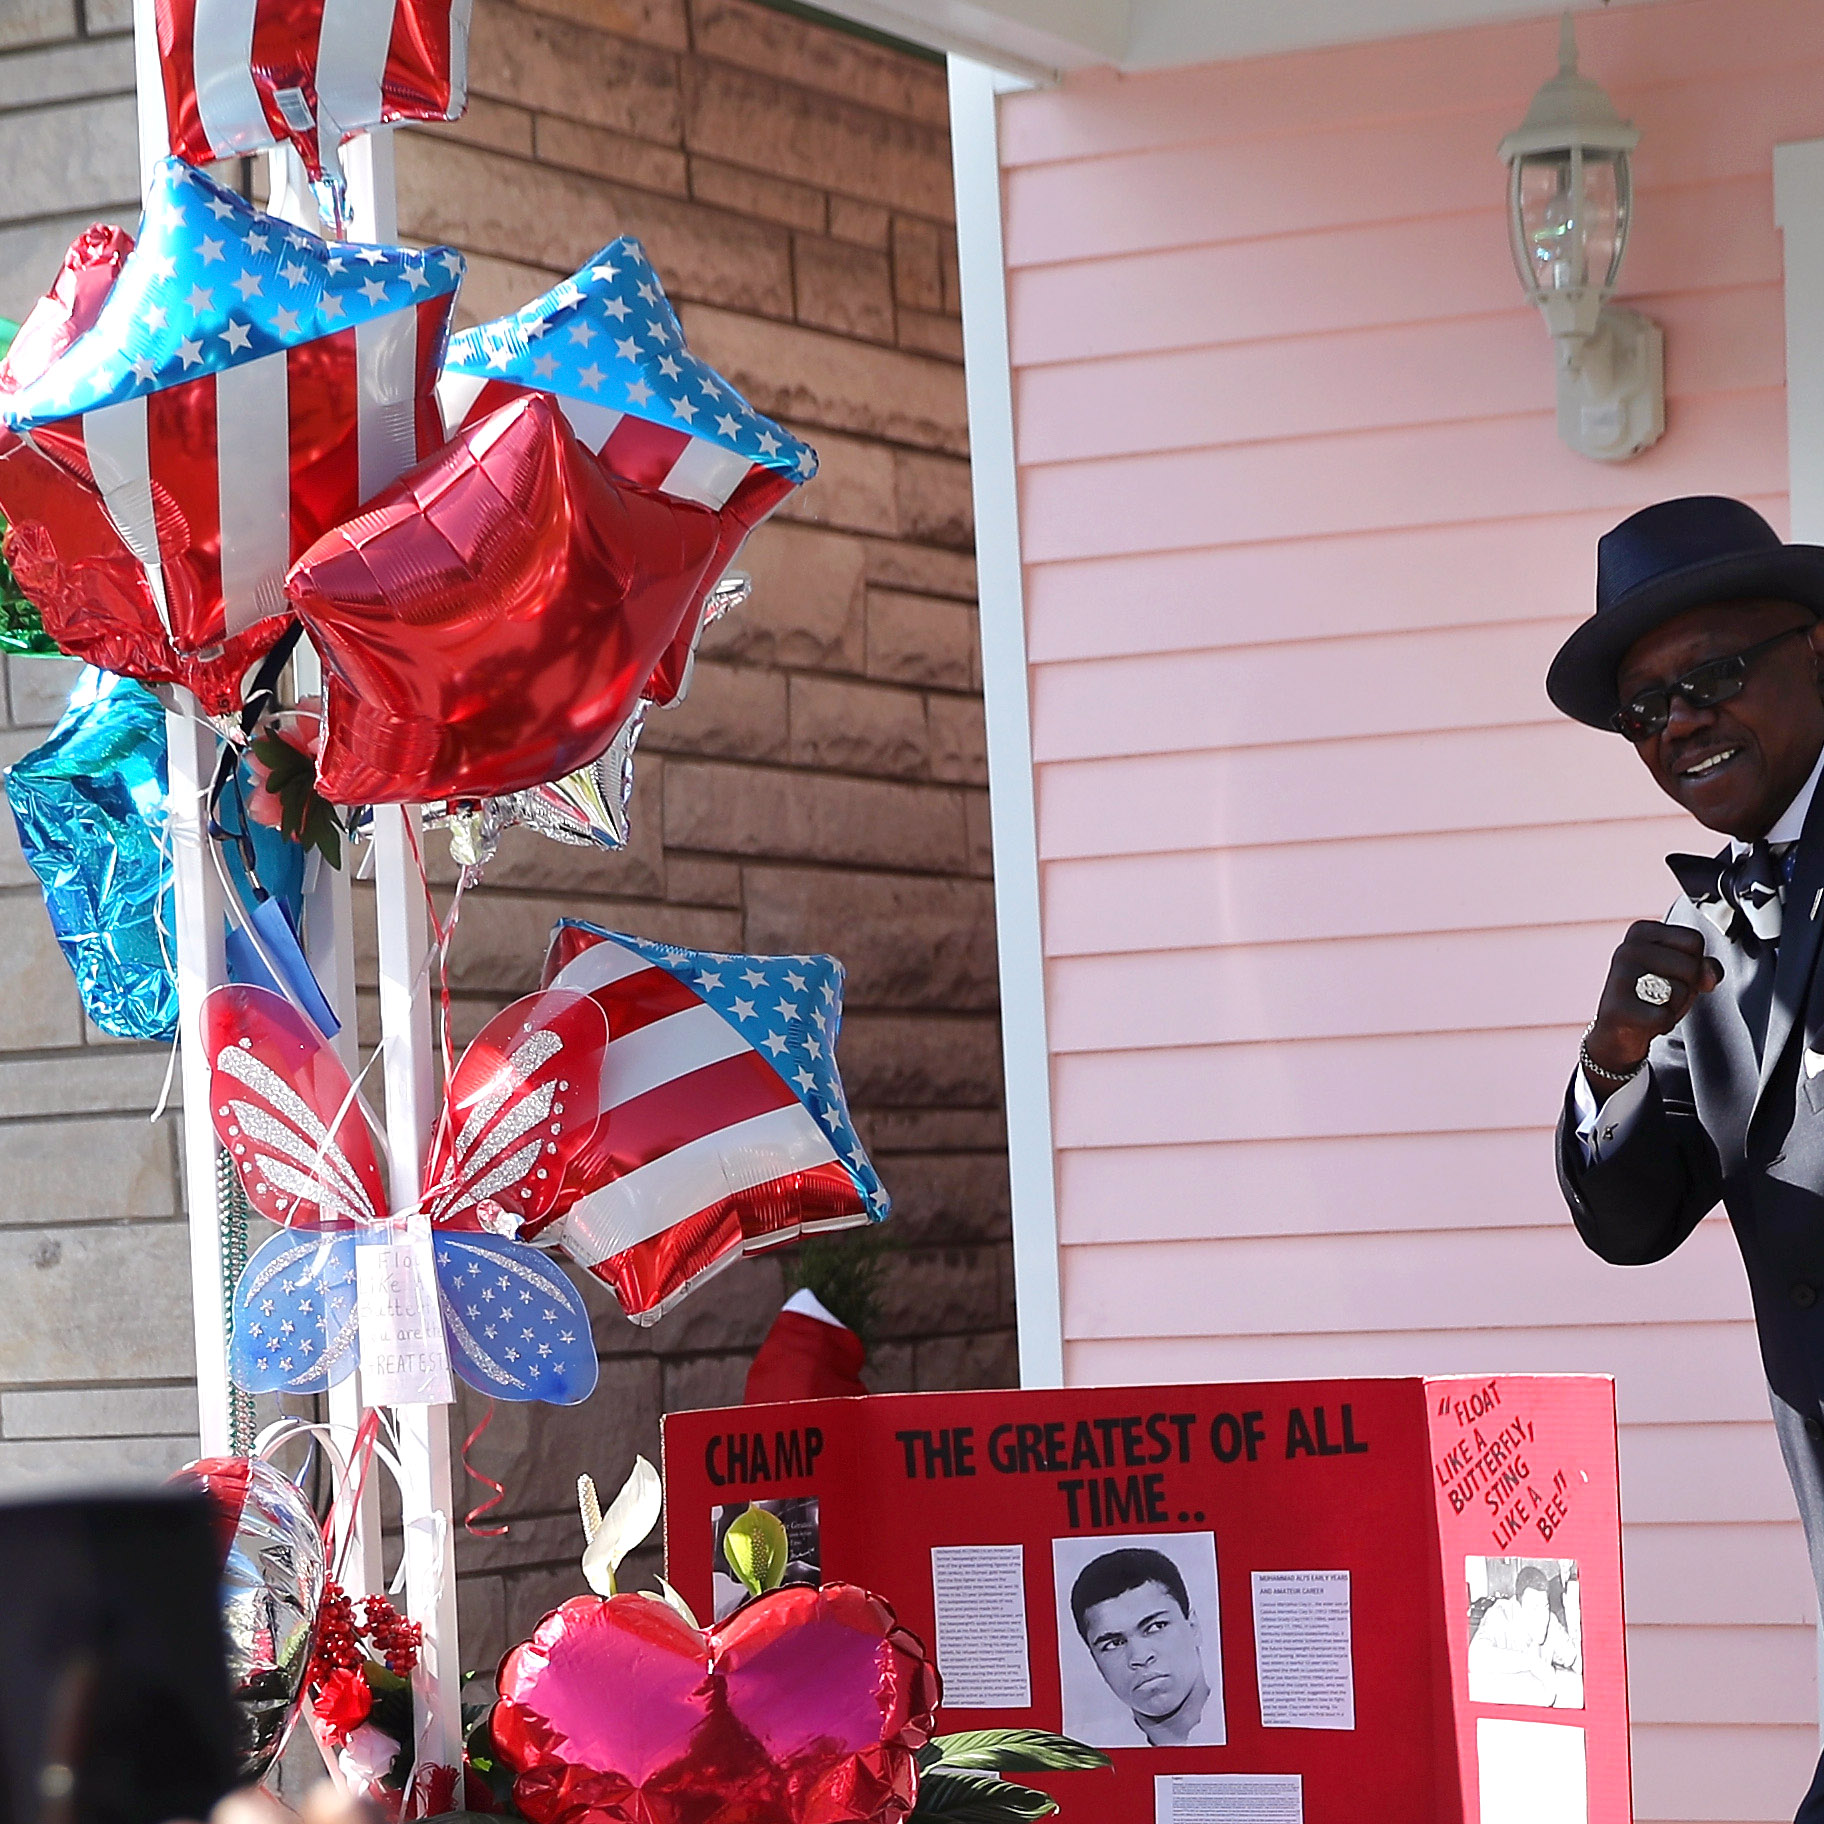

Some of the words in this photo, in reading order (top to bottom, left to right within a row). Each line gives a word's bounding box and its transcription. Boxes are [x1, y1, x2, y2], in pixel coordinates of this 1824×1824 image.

[705, 1427, 824, 1486] CHAMP
[895, 1427, 977, 1480] THE
[988, 1412, 1195, 1475] GREATEST
[1210, 1415, 1266, 1463] OF
[1286, 1404, 1368, 1459] ALL
[1435, 1438, 1474, 1487] LIKE
[1473, 1428, 1488, 1453] A
[1447, 1415, 1535, 1516] BUTTERFLY,
[1484, 1454, 1531, 1516] STING
[1491, 1498, 1531, 1551] LIKE
[1527, 1485, 1543, 1510] A
[1259, 1587, 1273, 1595] AND
[1273, 1587, 1301, 1595] AMATEUR
[1302, 1587, 1324, 1595] CAREER
